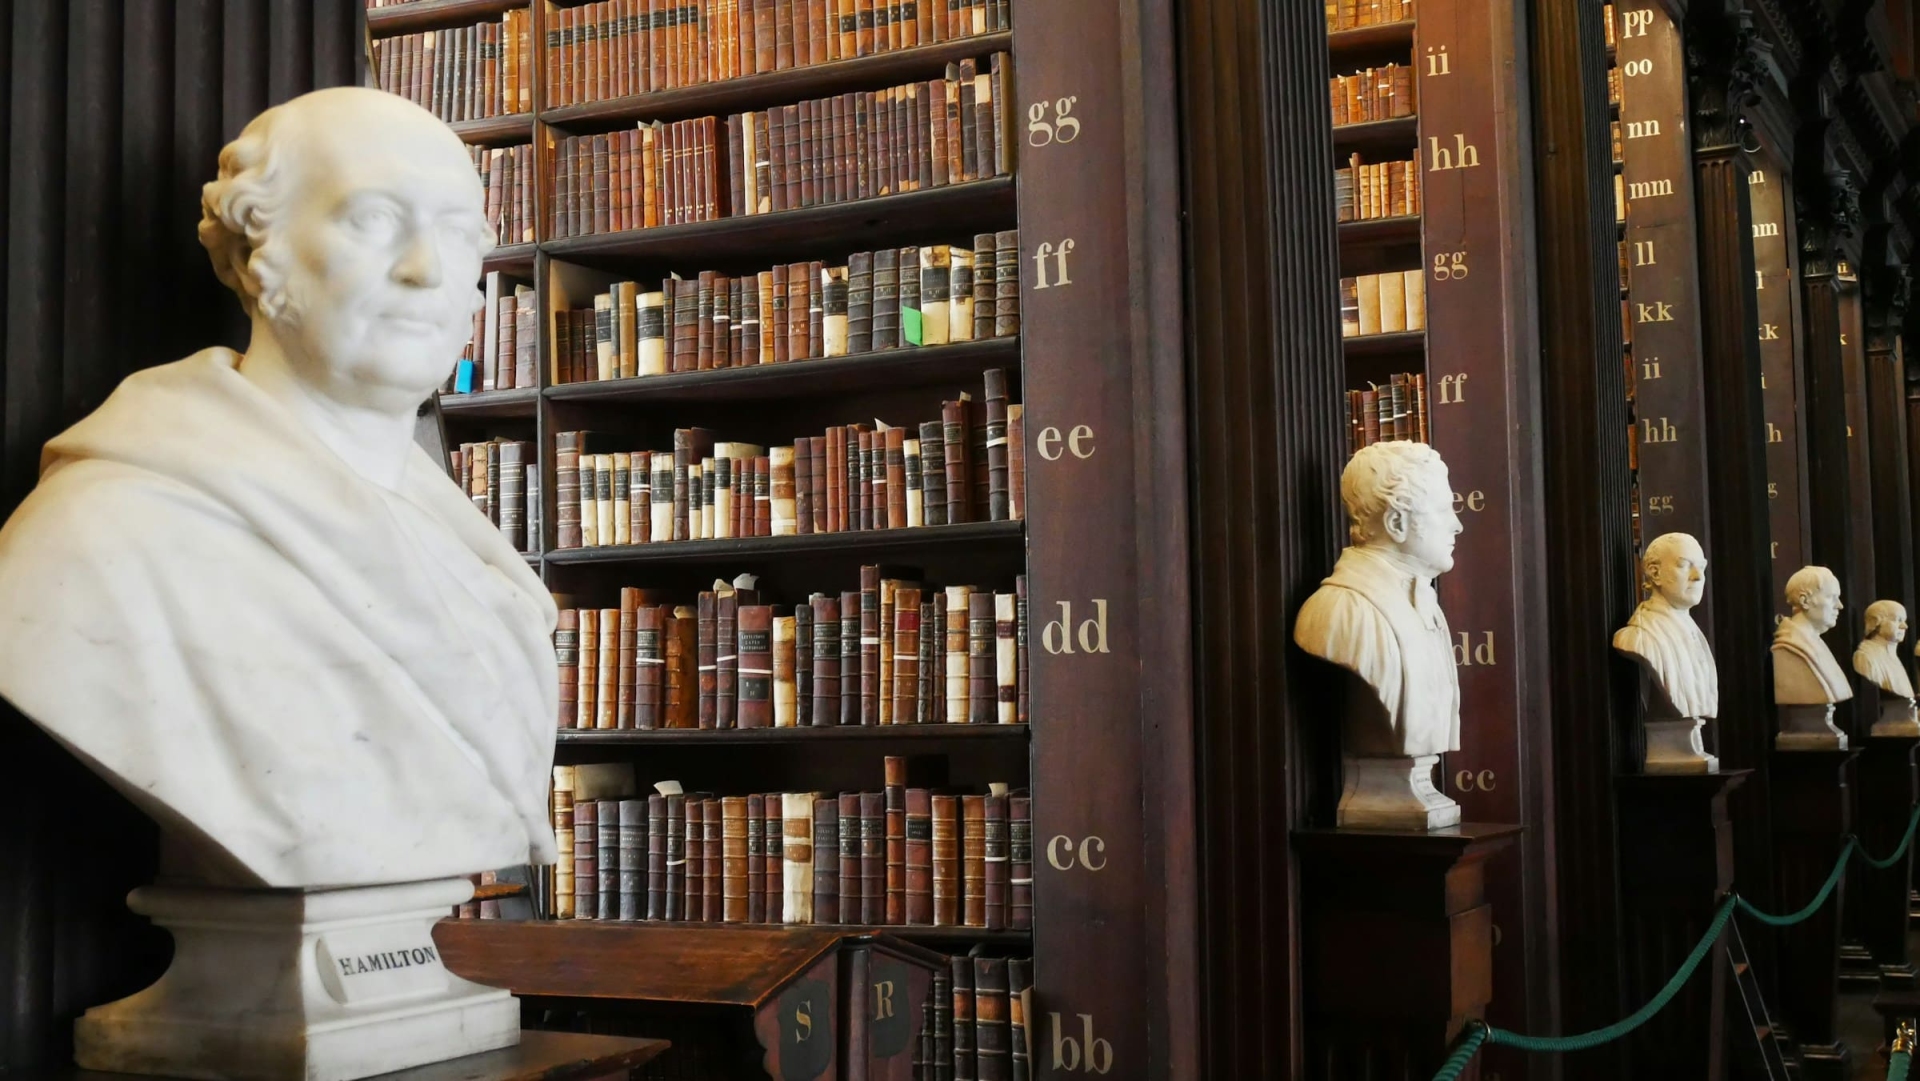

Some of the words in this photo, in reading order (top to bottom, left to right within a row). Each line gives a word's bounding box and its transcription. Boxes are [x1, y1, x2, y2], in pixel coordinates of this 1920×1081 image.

[1623, 10, 1653, 38] pp
[1427, 45, 1450, 76] ii
[1625, 59, 1652, 76] oo
[1029, 96, 1080, 147] gg
[1627, 120, 1660, 138] nn
[1429, 134, 1480, 171] hh
[1629, 179, 1673, 199] mm
[1032, 239, 1074, 289] ff
[1434, 252, 1467, 280] gg
[1635, 241, 1655, 266] ll
[1637, 302, 1673, 322] kk
[1759, 324, 1778, 340] k
[1643, 357, 1661, 379] ii
[1438, 373, 1467, 404] ff
[1037, 425, 1095, 460] ee
[1643, 417, 1677, 443] hh
[1453, 489, 1486, 513] ee
[1648, 495, 1674, 515] gg
[1042, 599, 1110, 654] dd
[1453, 631, 1497, 666] dd
[1456, 770, 1495, 791] cc
[1047, 835, 1106, 870] cc
[337, 946, 437, 976] HAMILTON
[874, 980, 895, 1021] R
[795, 999, 812, 1044] S
[1050, 1013, 1113, 1074] bb
